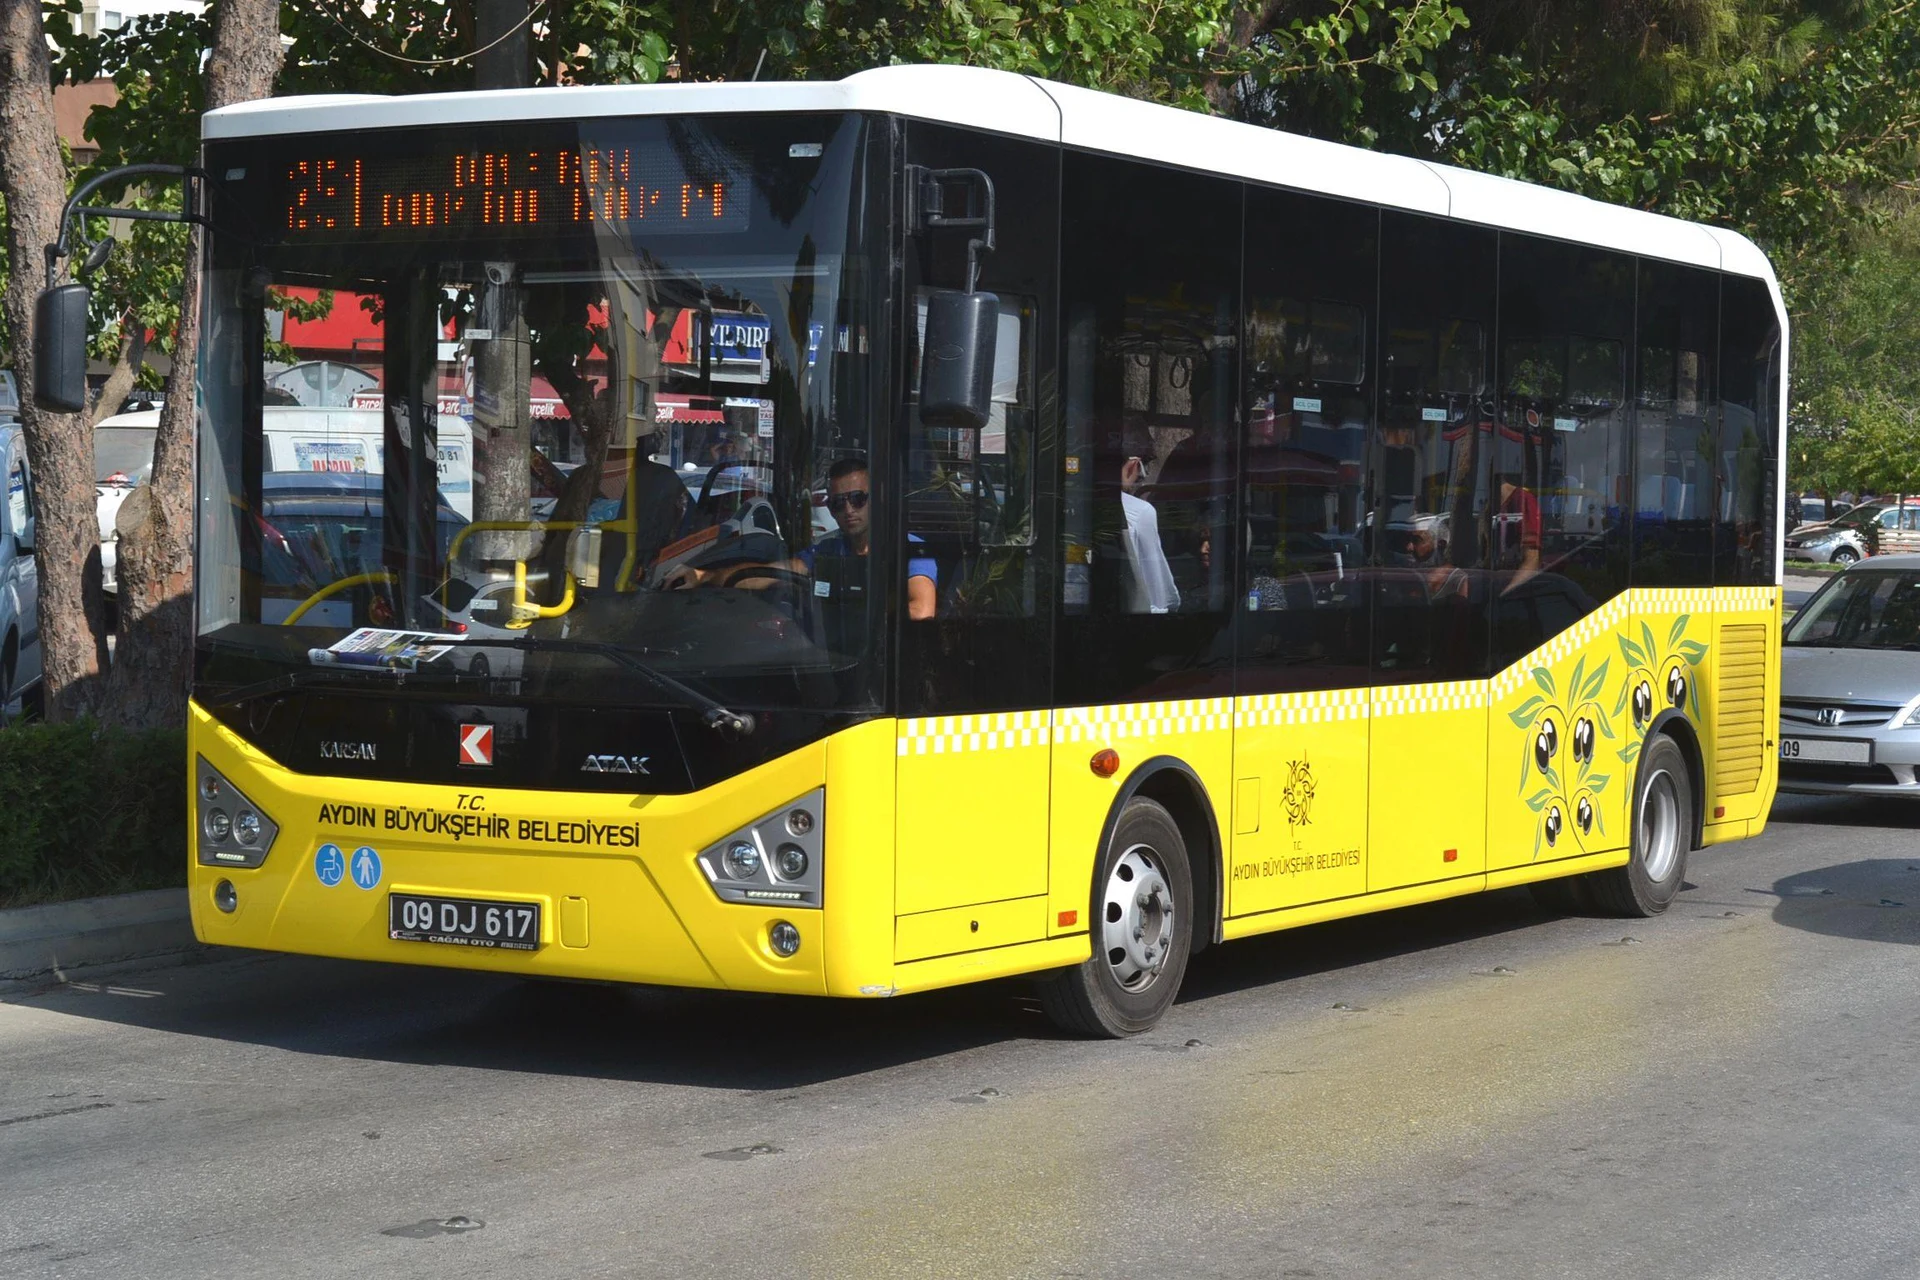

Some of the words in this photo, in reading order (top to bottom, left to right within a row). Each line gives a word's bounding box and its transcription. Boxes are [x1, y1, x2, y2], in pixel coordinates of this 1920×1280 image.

[320, 740, 377, 760] KARSAN
[1783, 740, 1800, 757] 09
[580, 754, 651, 775] ATAK
[456, 794, 486, 811] T.C.
[318, 803, 376, 828] AYDIN
[384, 805, 510, 841] BÜYÜKŞEHİR
[518, 819, 640, 847] BELEDİYESİ
[1233, 863, 1260, 881] AYDIN
[1262, 852, 1315, 878] BÜYÜKŞEHİR
[1316, 846, 1361, 871] BELEDİYESİ
[402, 900, 433, 930] 09
[440, 903, 477, 934] DJ
[485, 907, 533, 939] 617
[470, 937, 495, 947] OTO
